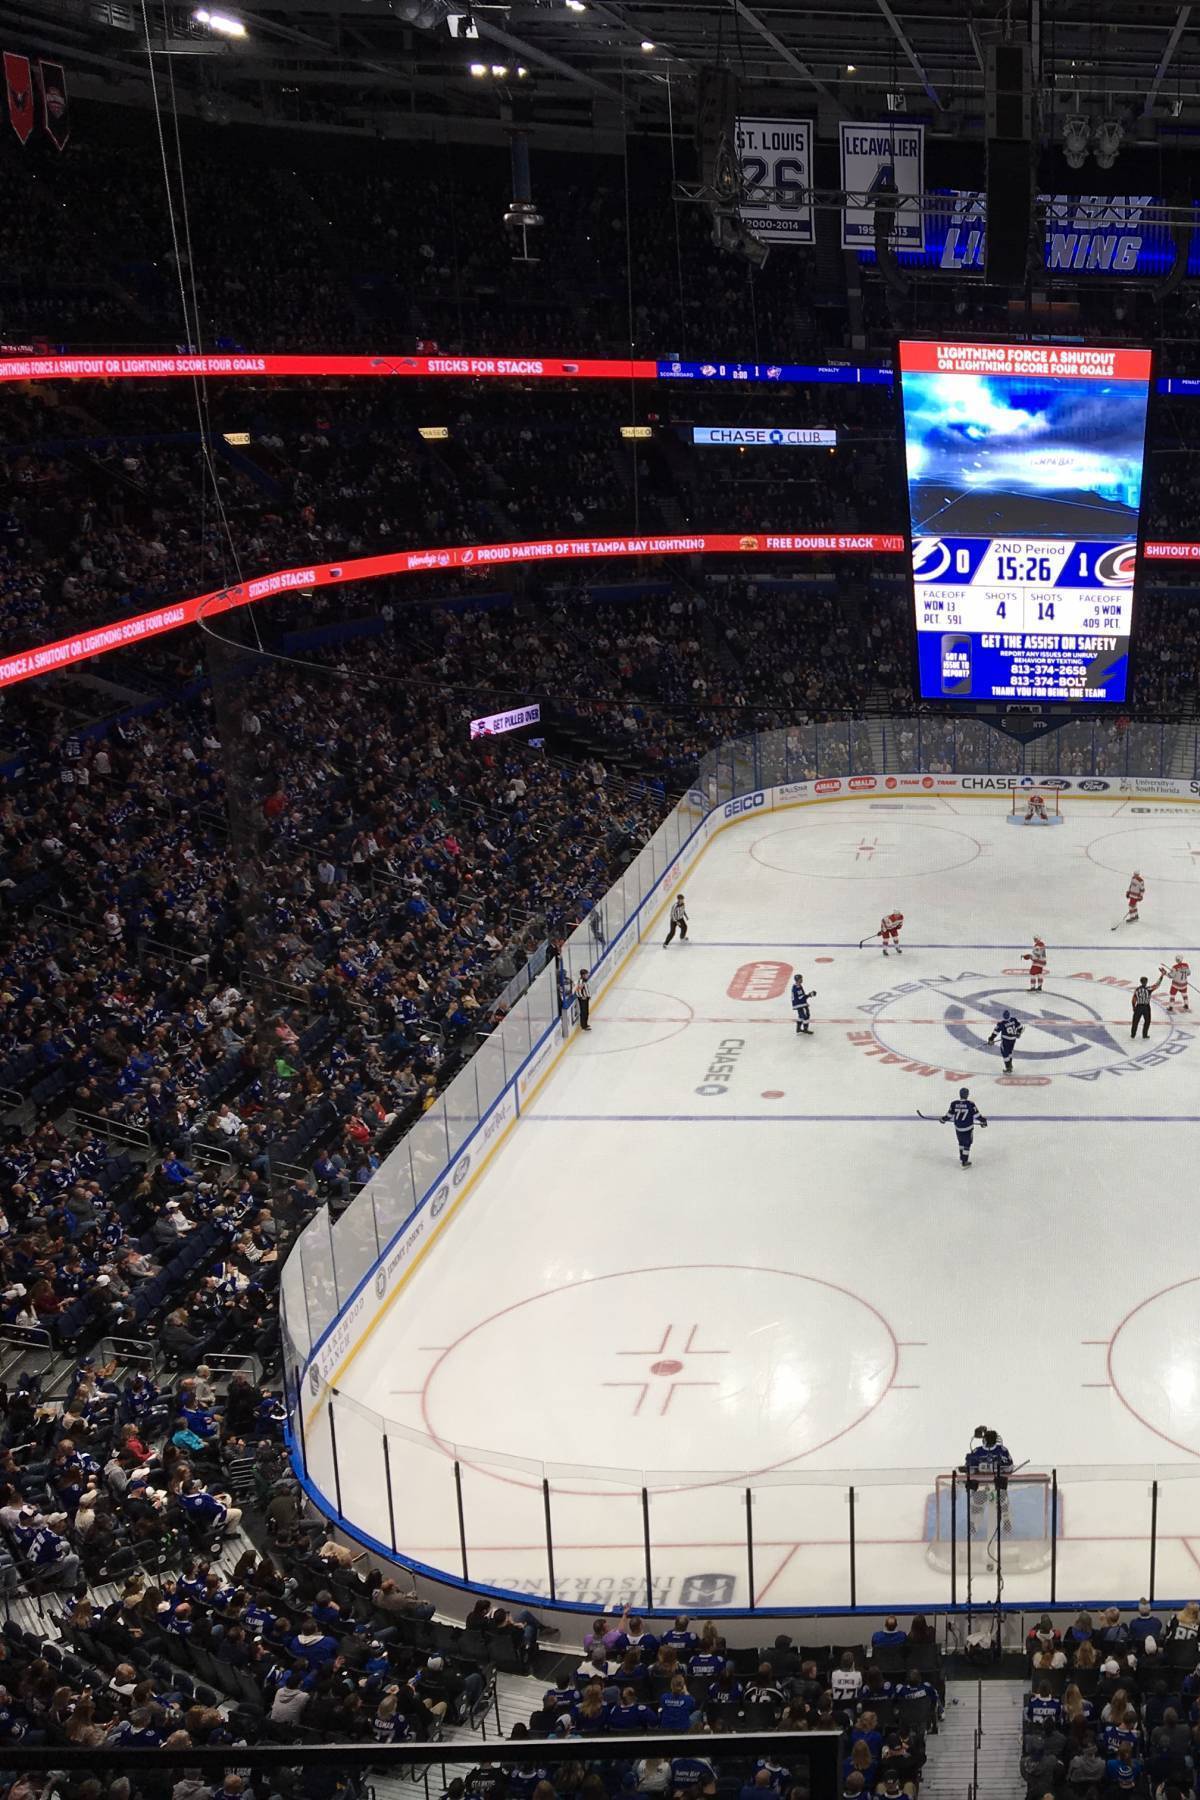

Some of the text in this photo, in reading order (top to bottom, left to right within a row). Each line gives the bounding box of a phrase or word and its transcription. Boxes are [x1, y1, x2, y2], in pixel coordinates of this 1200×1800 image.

[737, 130, 804, 151] ST. LOUIS
[846, 136, 917, 158] LECAVALIER
[742, 156, 805, 212] 26
[937, 347, 1116, 365] LIGHTNING FORCE A SHUTOUT
[60, 361, 103, 372] SHUTOUT
[106, 361, 120, 372] OR
[122, 360, 175, 372] LIGHTNING
[176, 360, 207, 371] SCORE
[208, 360, 232, 370] FOUR
[233, 359, 265, 370] GOALS
[428, 360, 543, 373] STICKS FOR STACKS
[938, 360, 1114, 376] OR LIGHTNING SCORE FOUR GOALS
[710, 430, 821, 443] CHASE CLUB
[477, 548, 509, 560] PROUD
[512, 545, 553, 557] PARTNER
[555, 544, 569, 554] OF
[570, 543, 590, 553] THE
[591, 542, 627, 552] TAMPA
[627, 541, 648, 551] BAY
[649, 539, 705, 550] LIGHTNING
[767, 538, 873, 548] FREE DOUBLE STACK
[994, 543, 1065, 556] 2ND Period
[1146, 546, 1190, 555] SHUTOUT
[956, 549, 970, 574] 0
[997, 556, 1051, 581] 15:26
[1079, 552, 1088, 577] 1
[280, 571, 316, 586] STACKS
[923, 590, 966, 599] FACEOFF
[985, 592, 1017, 601] SHOTS
[1030, 593, 1063, 602] SHOTS
[1079, 594, 1121, 603] FACEOFF
[924, 601, 944, 611] WON
[996, 601, 1006, 619] 4
[1038, 602, 1055, 620] 14
[1102, 605, 1121, 615] WON
[35, 645, 69, 668] SHUTOUT
[70, 641, 82, 656] OR
[82, 628, 122, 652] LIGHTNING
[122, 620, 145, 638] SCORE
[145, 615, 164, 631] FOUR
[164, 608, 184, 624] GOALS
[981, 635, 1002, 648] GET
[1003, 635, 1022, 649] THE
[1024, 636, 1060, 649] ASSIST
[1078, 637, 1117, 650] SAFETY
[1011, 665, 1087, 676] 813-374-2658
[1010, 676, 1087, 687] 813-374-BOLT
[992, 687, 1015, 697] THANK
[1016, 687, 1032, 697] YOU
[1032, 687, 1046, 697] FOR
[1047, 687, 1069, 697] BEING
[1069, 688, 1084, 698] ONE
[961, 777, 1017, 790] CHASE
[724, 793, 764, 818] GEICO
[856, 970, 989, 1014] ARENA
[704, 1038, 745, 1081] CHASE
[1068, 1030, 1196, 1081] ARENA
[954, 1108, 968, 1121] 77
